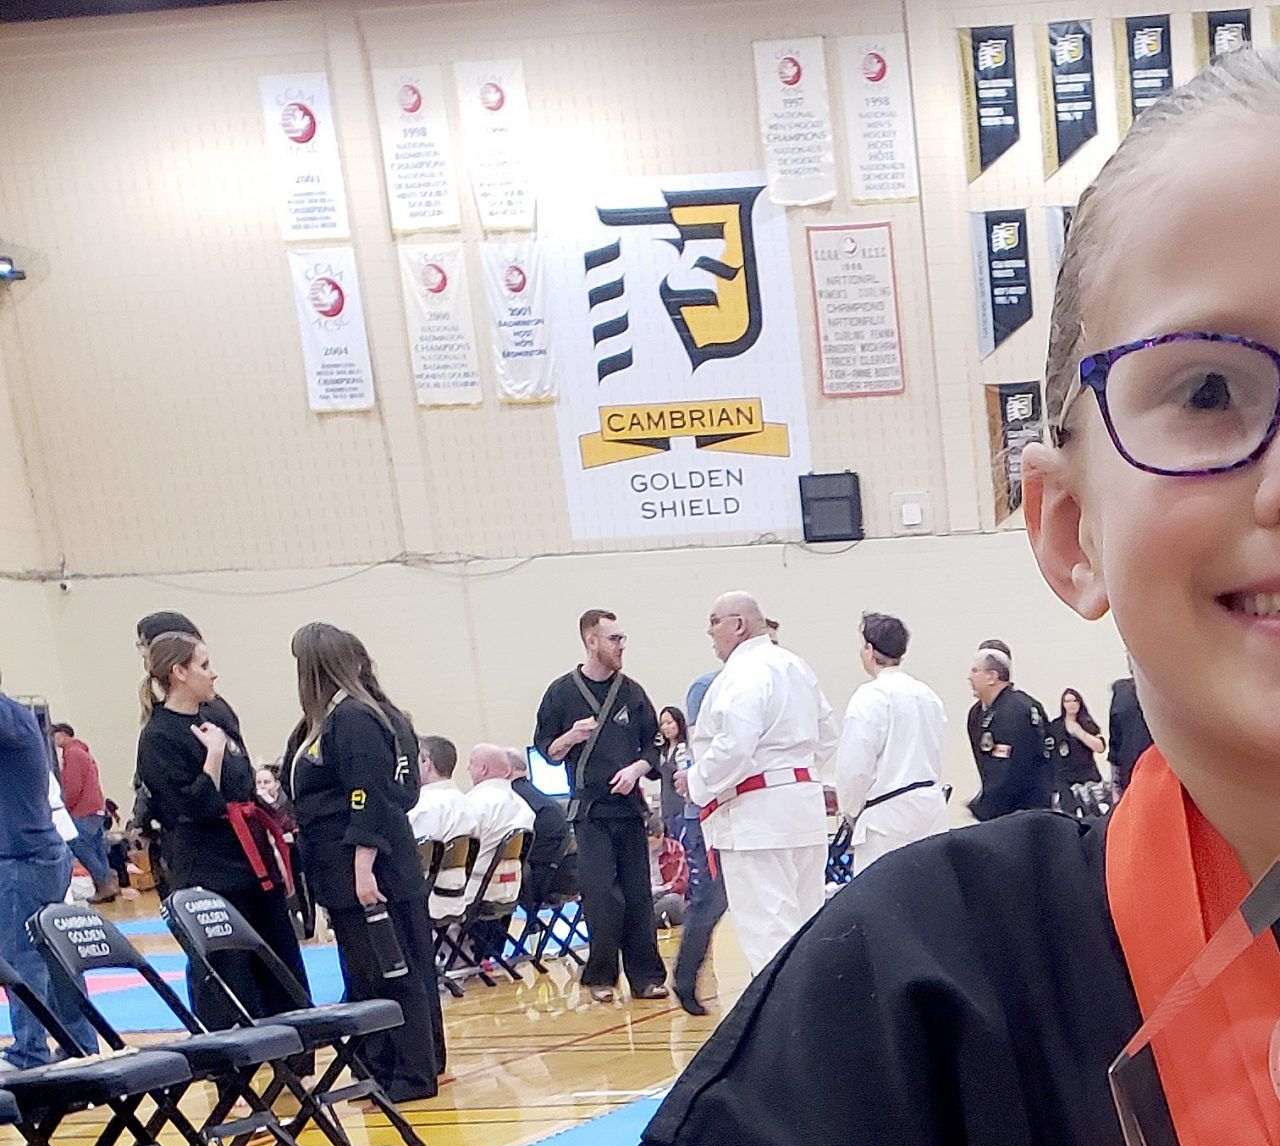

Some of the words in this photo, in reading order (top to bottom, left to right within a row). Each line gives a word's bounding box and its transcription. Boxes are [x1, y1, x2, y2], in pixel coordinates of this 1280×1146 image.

[607, 405, 753, 433] CAMBRIAN
[631, 468, 743, 493] GOLDEN
[641, 497, 740, 520] SHIELD
[184, 898, 226, 913] CAMBRIAN
[53, 914, 103, 931] CAMBRIAN
[196, 910, 229, 925] GOLDEN
[67, 929, 106, 944] GOLDEN
[204, 923, 233, 939] SHIELD
[78, 943, 110, 958] SHIELD
